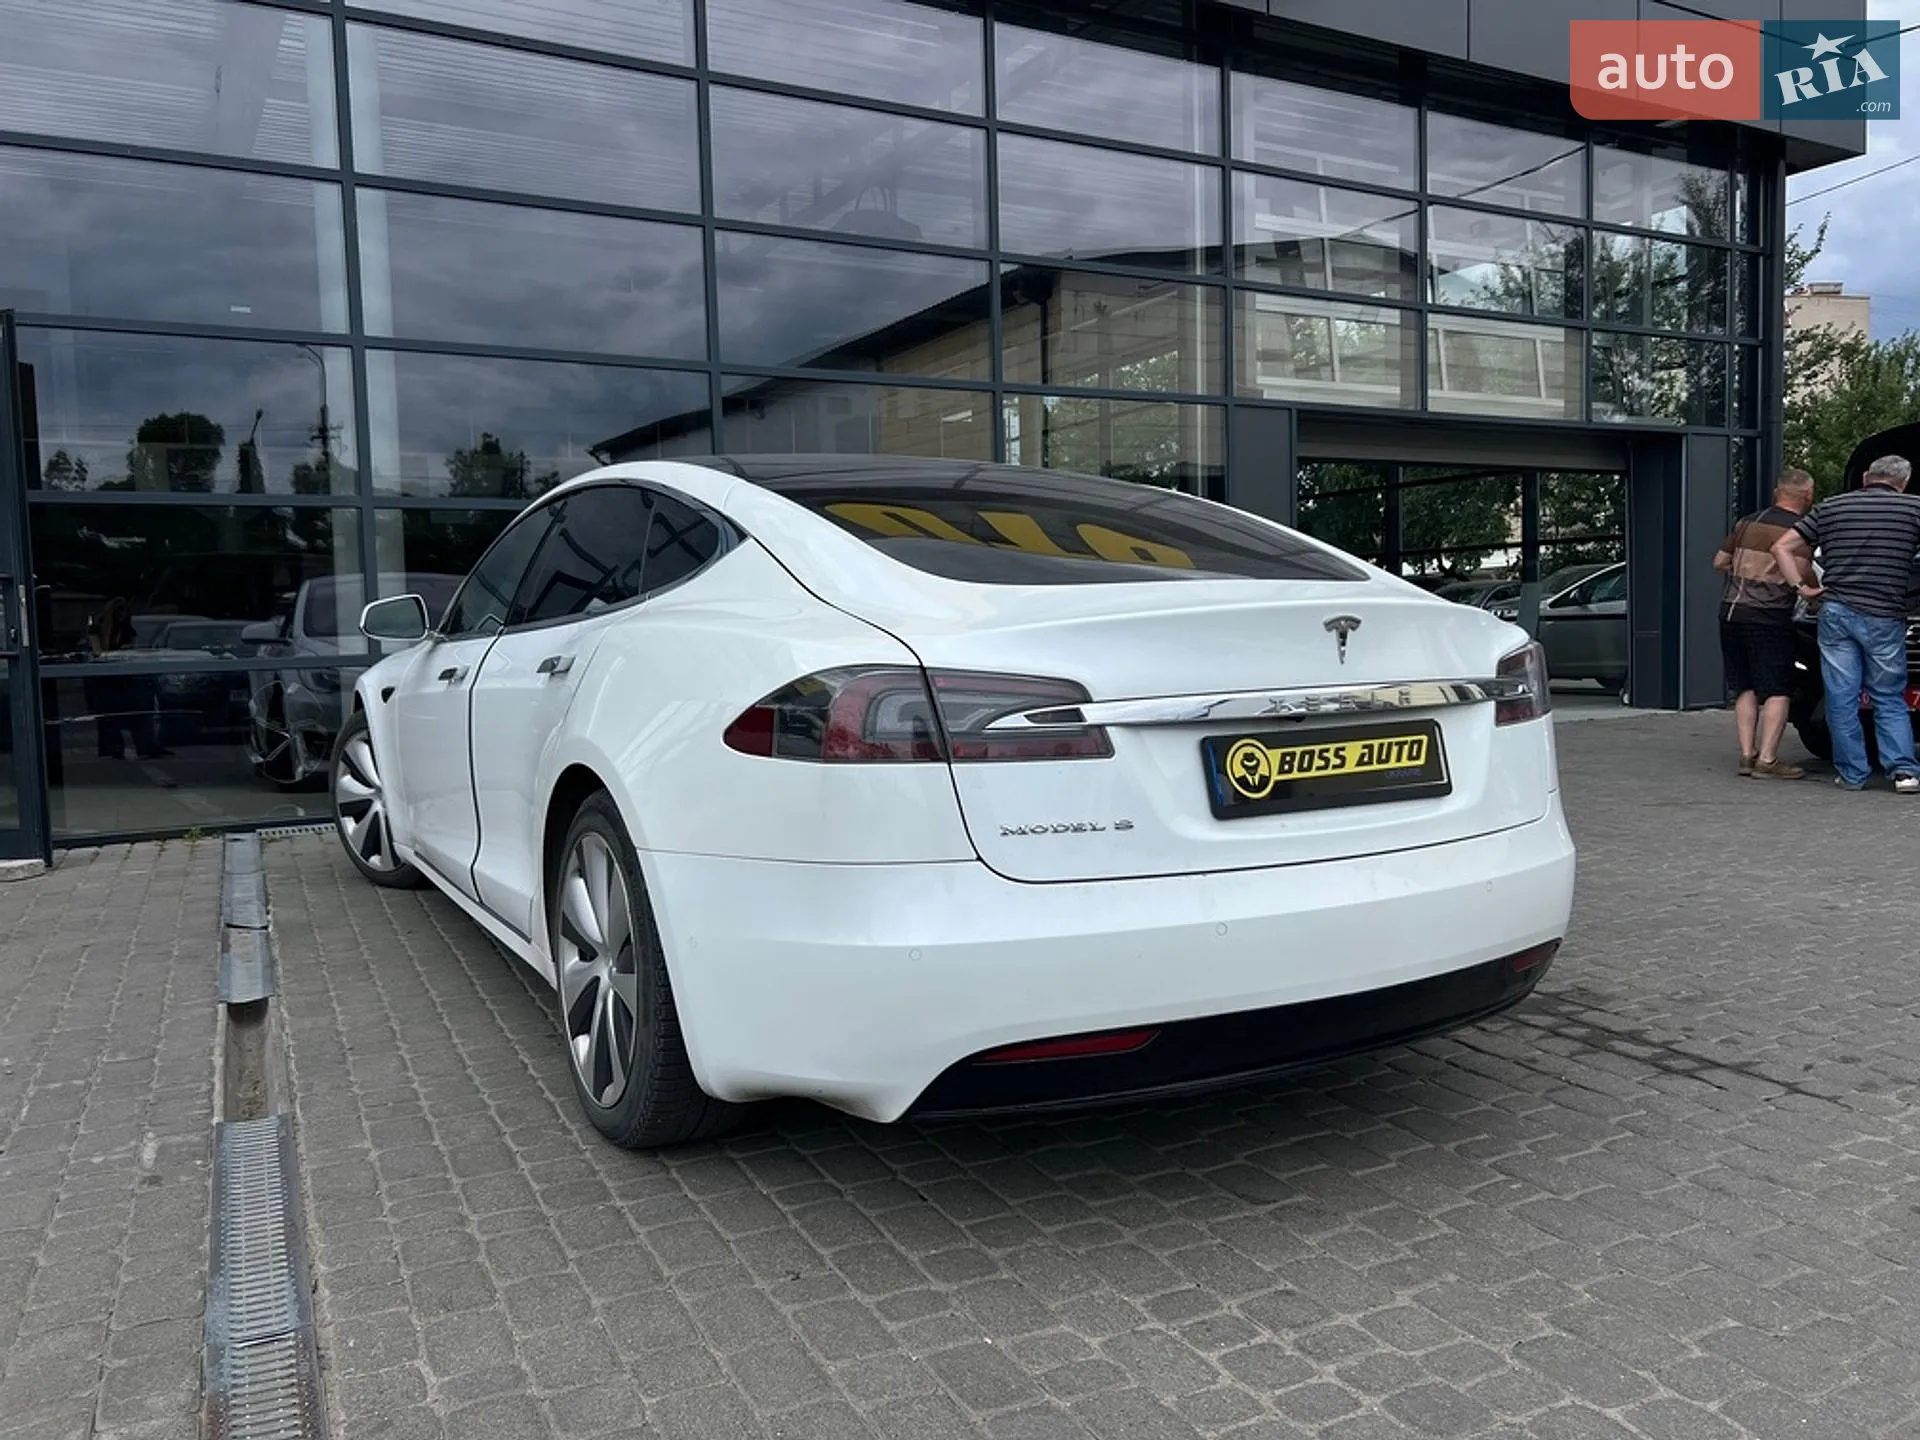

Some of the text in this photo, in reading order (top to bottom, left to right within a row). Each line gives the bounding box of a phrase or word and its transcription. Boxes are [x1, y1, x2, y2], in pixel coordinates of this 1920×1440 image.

[1278, 739, 1424, 775] BOSS AUTO
[1000, 818, 1135, 837] MODEL S
